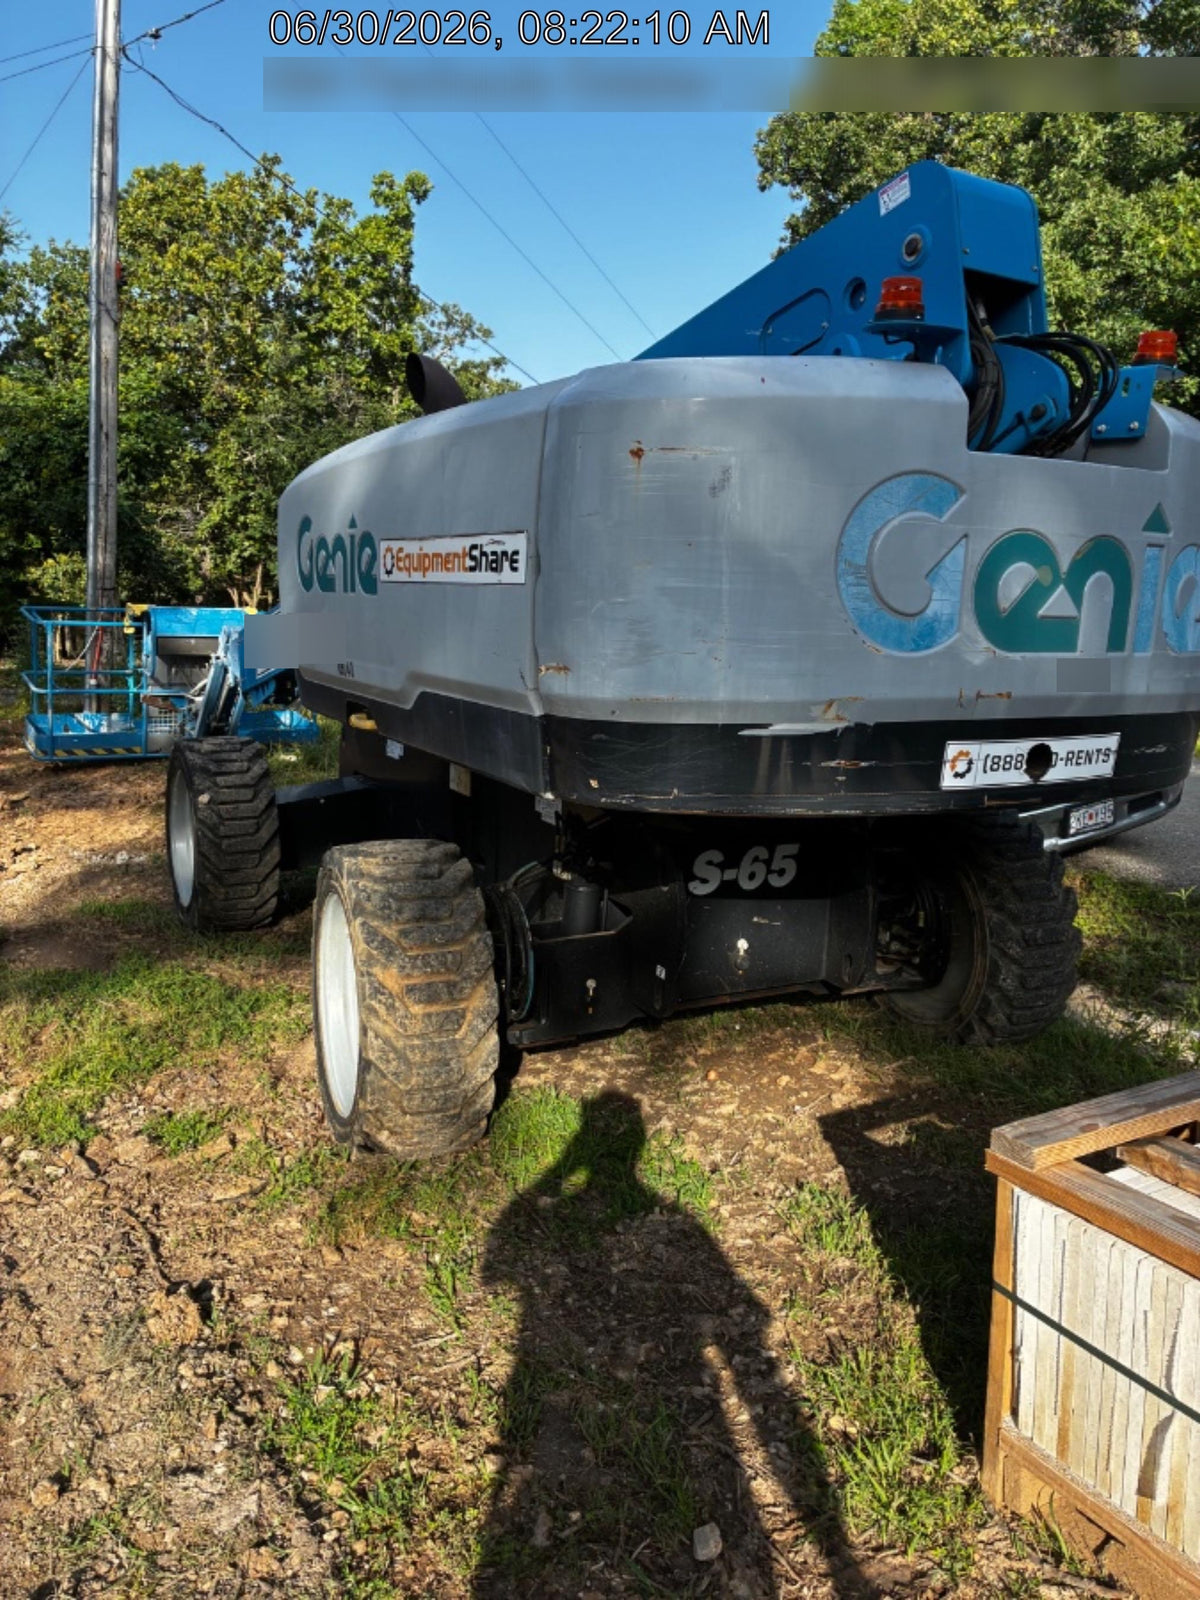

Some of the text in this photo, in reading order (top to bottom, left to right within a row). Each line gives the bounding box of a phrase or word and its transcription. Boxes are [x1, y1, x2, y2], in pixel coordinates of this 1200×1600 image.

[297, 512, 378, 596] Genie
[395, 543, 520, 579] EquipmentShare
[836, 470, 1200, 655] Genie
[983, 747, 1112, 774] (888 0-RENTS
[687, 843, 801, 896] S-65
